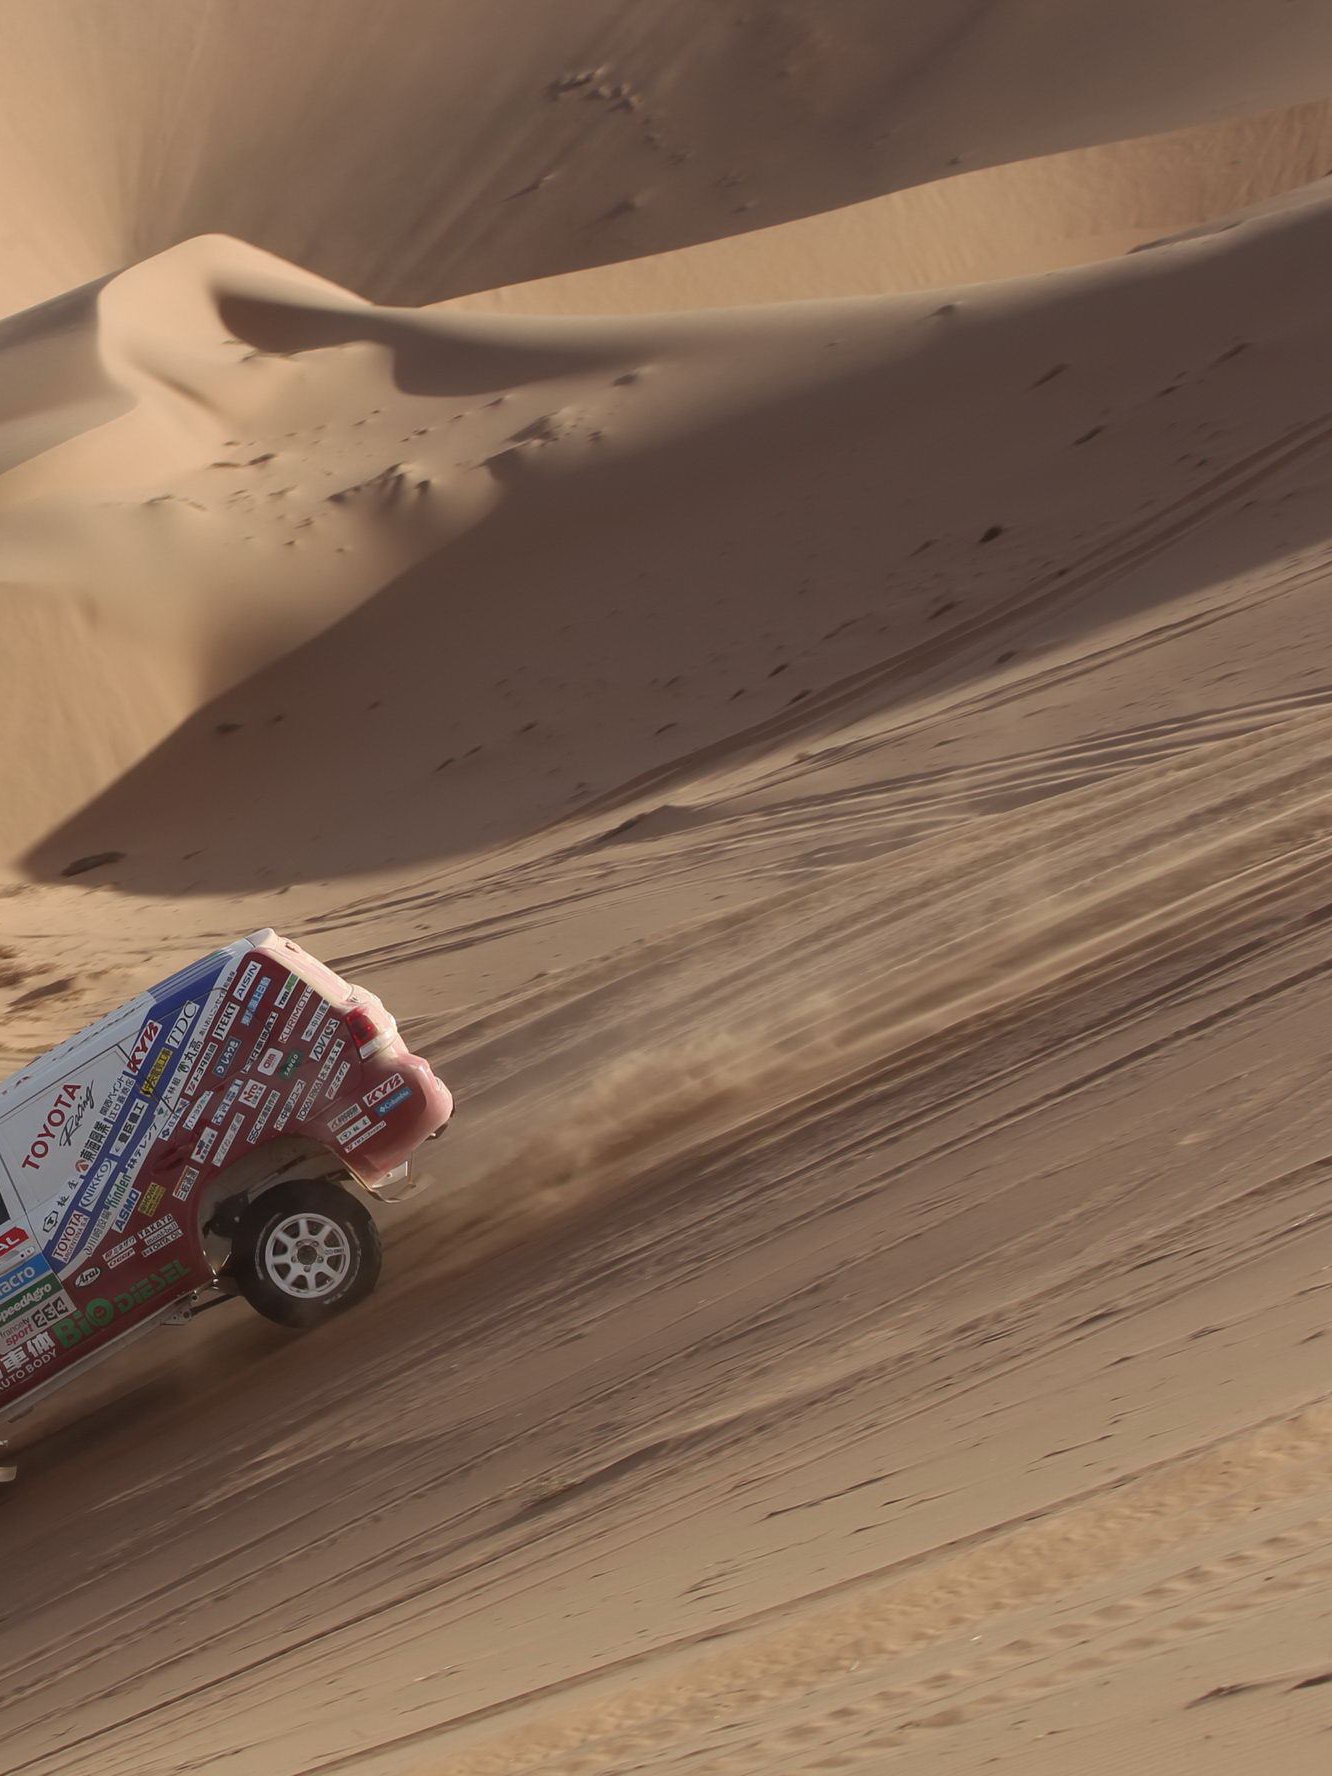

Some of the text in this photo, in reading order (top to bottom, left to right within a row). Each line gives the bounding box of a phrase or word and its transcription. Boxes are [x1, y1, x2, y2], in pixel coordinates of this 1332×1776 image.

[236, 963, 257, 997] AISIN
[166, 1001, 199, 1047] TDC
[214, 1003, 236, 1038] JTEKT
[311, 1018, 338, 1059] ADVICS
[125, 1021, 160, 1073] KYB
[364, 1076, 401, 1105] KYB
[21, 1077, 81, 1174] TOYOTA
[60, 1079, 94, 1145] Racing
[82, 1162, 110, 1202] NIKKO
[104, 1171, 132, 1209] Kinden
[113, 1189, 139, 1231] ASMO
[138, 1214, 173, 1238] TAKATA
[52, 1211, 82, 1259] TOYOTA
[62, 1227, 83, 1262] ARGENTINA
[4, 1322, 34, 1347] sport
[24, 1348, 58, 1374] BODY
